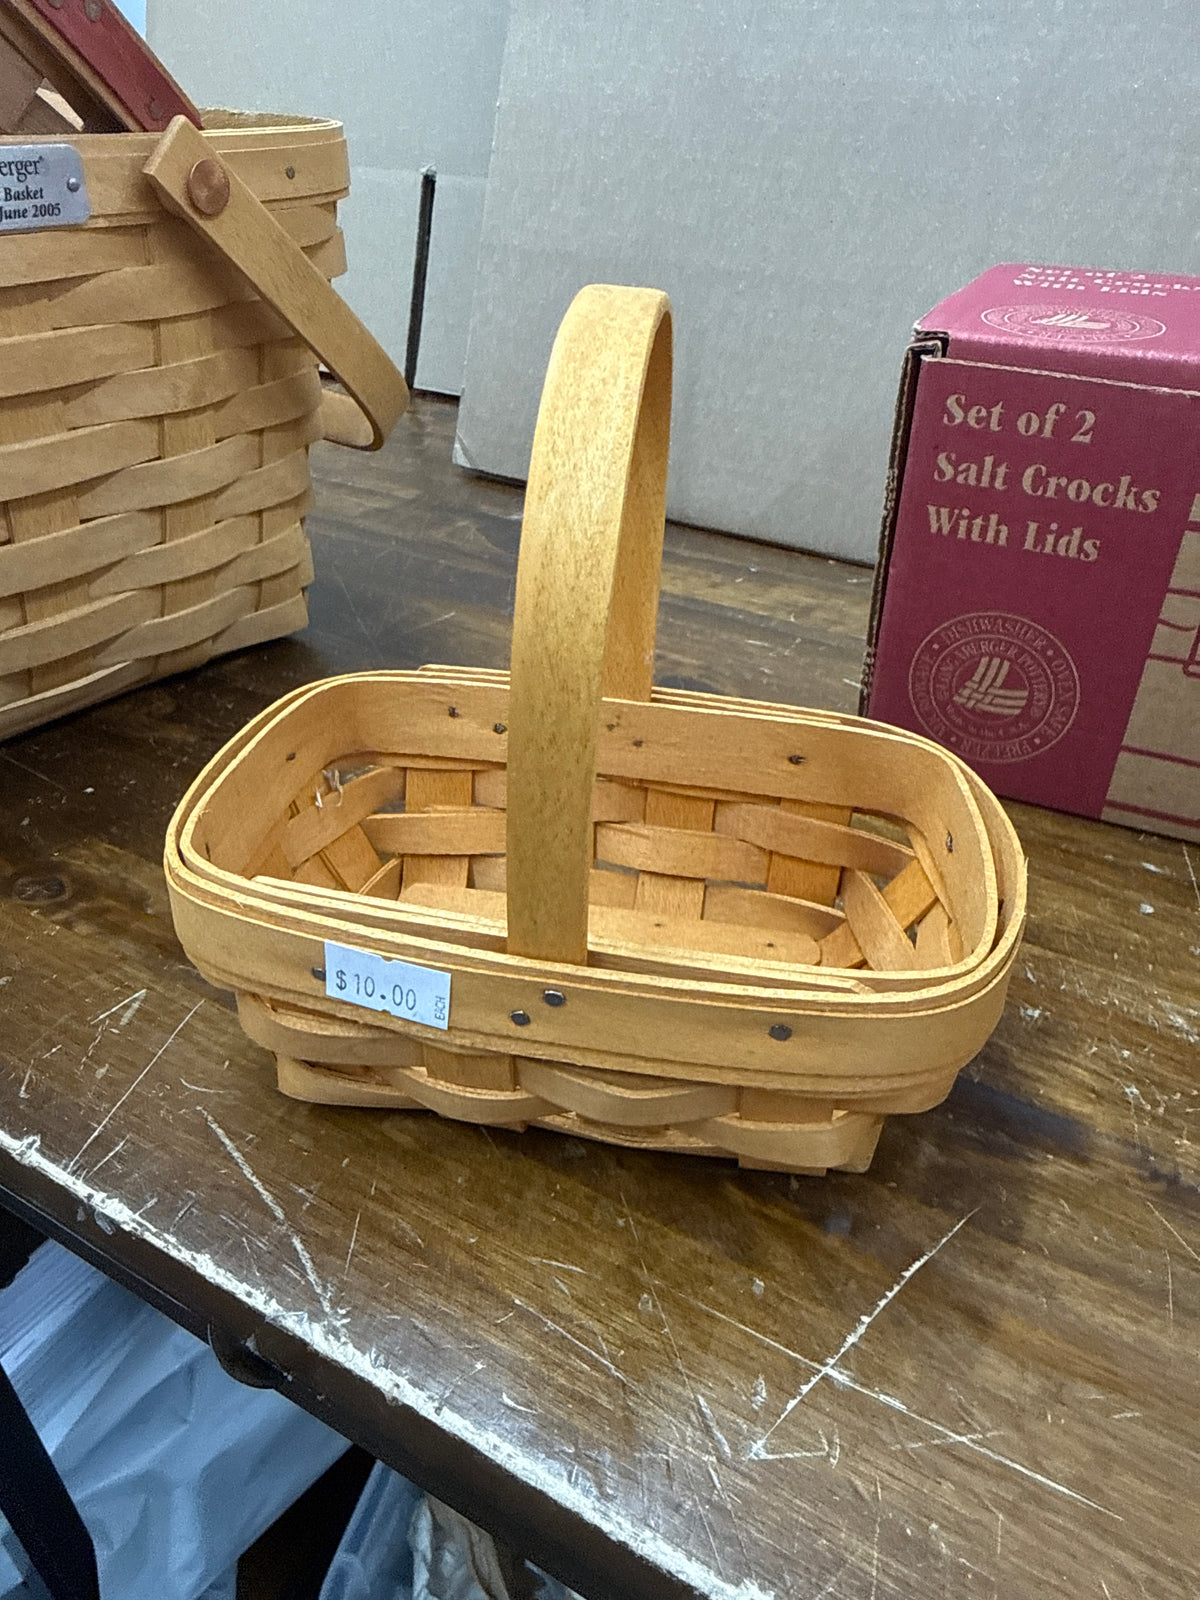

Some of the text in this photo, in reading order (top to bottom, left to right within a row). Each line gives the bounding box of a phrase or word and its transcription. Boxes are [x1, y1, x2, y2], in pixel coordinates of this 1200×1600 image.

[4, 186, 44, 202] Basket
[31, 203, 61, 218] 2005
[943, 393, 1096, 444] Set of 2
[934, 451, 1161, 514] Salt Crocks
[927, 504, 1101, 563] With Lids
[335, 969, 418, 1011] $10.00
[434, 995, 446, 1021] EACH
